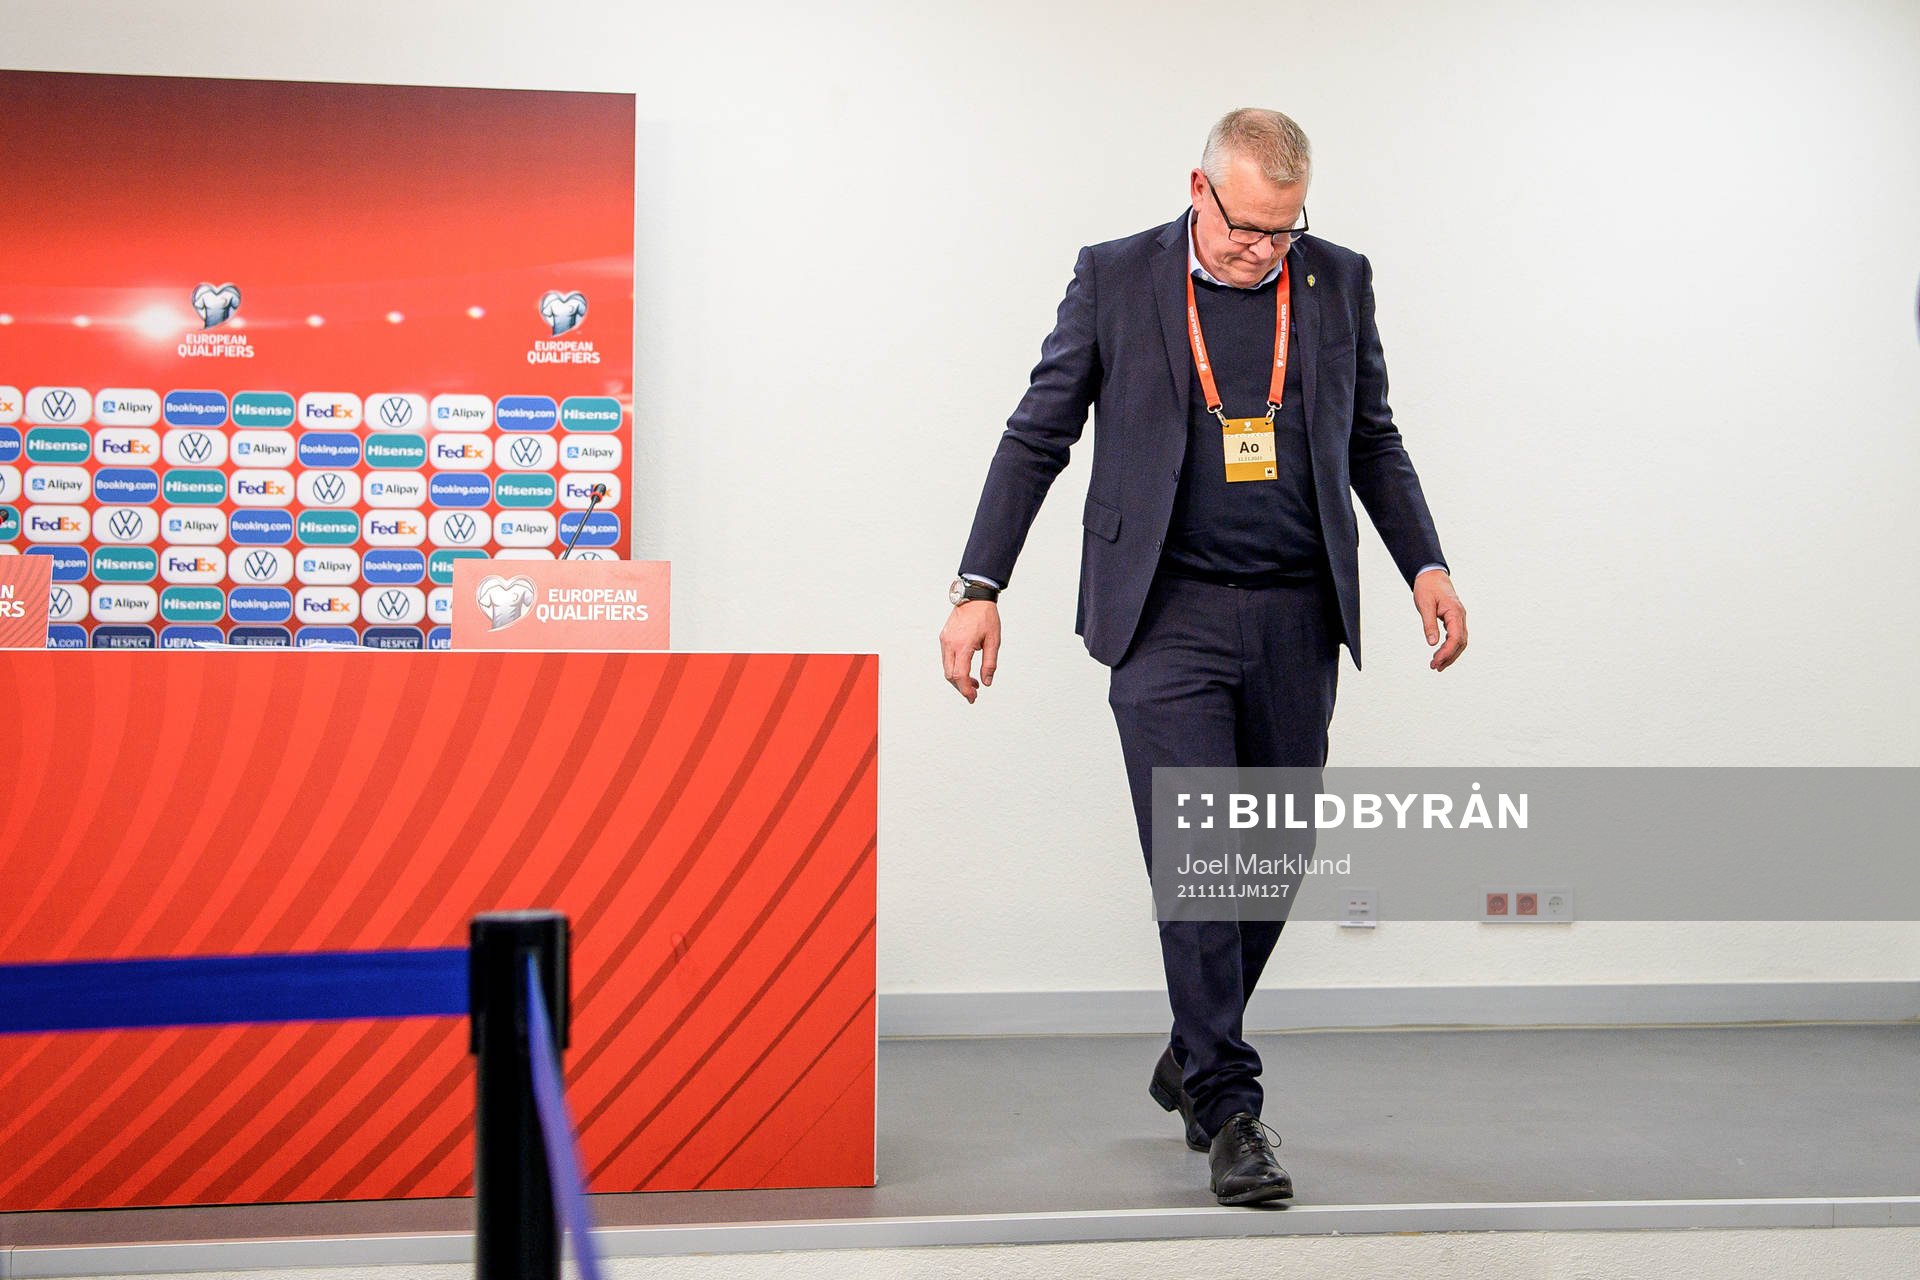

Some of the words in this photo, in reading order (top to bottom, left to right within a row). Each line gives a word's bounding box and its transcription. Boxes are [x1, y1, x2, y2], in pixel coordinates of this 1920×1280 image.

[186, 334, 246, 344] EUROPEAN
[178, 344, 254, 358] QUALIFIERS
[534, 341, 593, 352] EUROPEAN
[528, 351, 600, 364] QUALIFIERS
[118, 402, 152, 414] Alipay
[167, 403, 226, 414] Booking.com
[235, 404, 292, 416] Hisense
[306, 404, 353, 419] FedEx
[452, 408, 485, 419] Alipay
[498, 408, 554, 419] Booking.com
[564, 409, 618, 420] Hisense
[29, 439, 87, 452] Hisense
[103, 440, 150, 454] FedEx
[253, 443, 287, 455] Alipay
[301, 444, 358, 456] Booking.com
[368, 446, 423, 457] Hisense
[438, 445, 483, 458] FedEx
[1240, 441, 1259, 454] Ao
[582, 448, 614, 458] Alipay
[48, 479, 82, 490] Alipay
[97, 480, 156, 491] Booking.com
[166, 481, 223, 493] Hisense
[238, 481, 285, 495] FedEx
[386, 484, 418, 495] Alipay
[432, 485, 488, 495] Booking.com
[567, 484, 612, 497] Fedx
[498, 486, 552, 496] Hisense
[32, 517, 81, 531] FedEx
[185, 520, 219, 531] Alipay
[232, 522, 291, 533] Booking.com
[301, 522, 356, 534] Hisense
[371, 521, 417, 535] FedEx
[515, 523, 548, 535] Alipay
[561, 523, 617, 535] Booing.com
[53, 558, 86, 569] ng.com
[96, 559, 154, 570] Hisense
[169, 558, 216, 572] FedEx
[319, 561, 352, 573] Alipay
[365, 561, 422, 572] Booking.com
[548, 589, 637, 603] EUROPEAN
[114, 598, 149, 609] Alipay
[164, 599, 221, 611] Hisense
[231, 599, 289, 610] Booking.com
[304, 598, 350, 612] FedEx
[536, 604, 648, 622] QUALIFIERS
[49, 637, 83, 647] A.com
[110, 638, 151, 647] RESPECT
[380, 639, 419, 648] RESPECT
